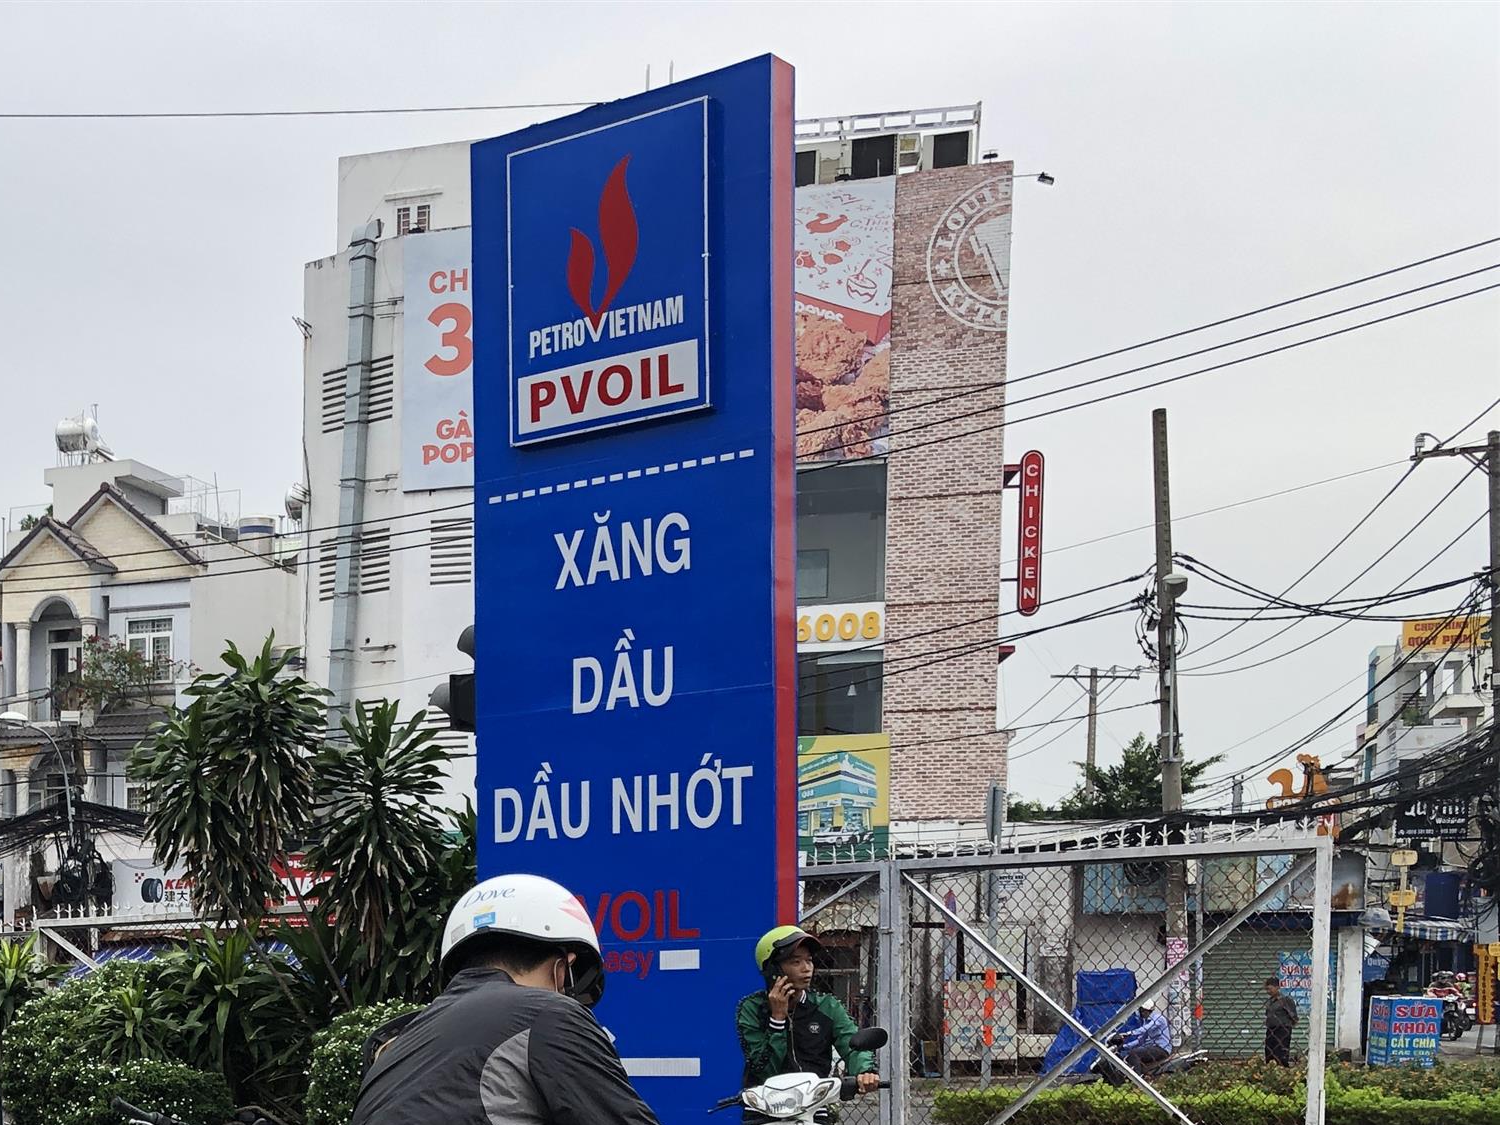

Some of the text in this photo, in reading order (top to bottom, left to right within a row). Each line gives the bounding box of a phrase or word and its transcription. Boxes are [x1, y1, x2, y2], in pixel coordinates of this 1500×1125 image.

[429, 268, 468, 294] CH
[529, 294, 684, 359] PETROVIETNAM
[530, 353, 685, 424] PVOIL
[436, 410, 472, 440] GÀ
[554, 510, 691, 590] XĂNG
[1023, 464, 1039, 600] CHICKEN
[572, 628, 674, 714] DẦU
[494, 762, 590, 843] DẦU
[611, 753, 754, 834] NHỚT
[463, 888, 515, 909] Dove
